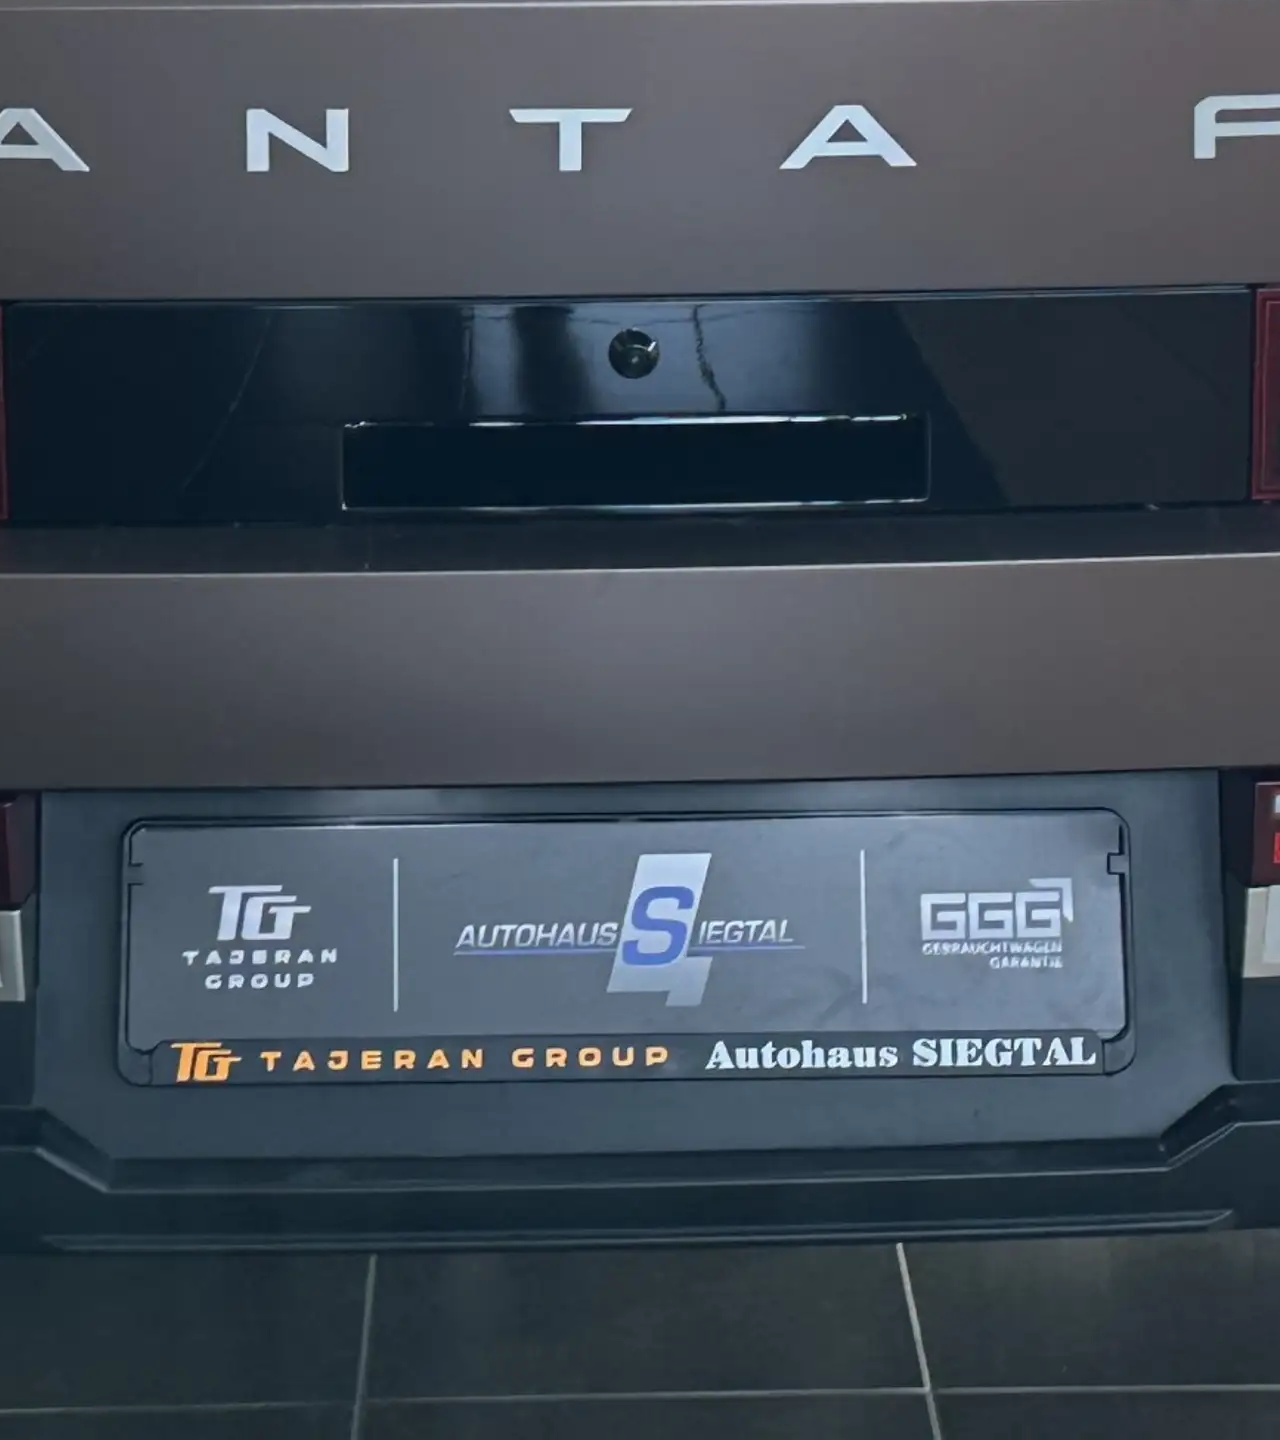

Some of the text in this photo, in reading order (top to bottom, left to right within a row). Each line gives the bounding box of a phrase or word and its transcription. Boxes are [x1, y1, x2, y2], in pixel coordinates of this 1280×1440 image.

[920, 890, 1062, 942] GGG
[455, 922, 619, 948] AUTOHAUS
[182, 948, 338, 966] TAJERAN
[204, 973, 315, 990] GROUP
[260, 1048, 483, 1072] TAJERAN
[510, 1045, 669, 1068] GROUP
[705, 1039, 899, 1071] Autohaus
[912, 1035, 1097, 1067] SIEGTAL
